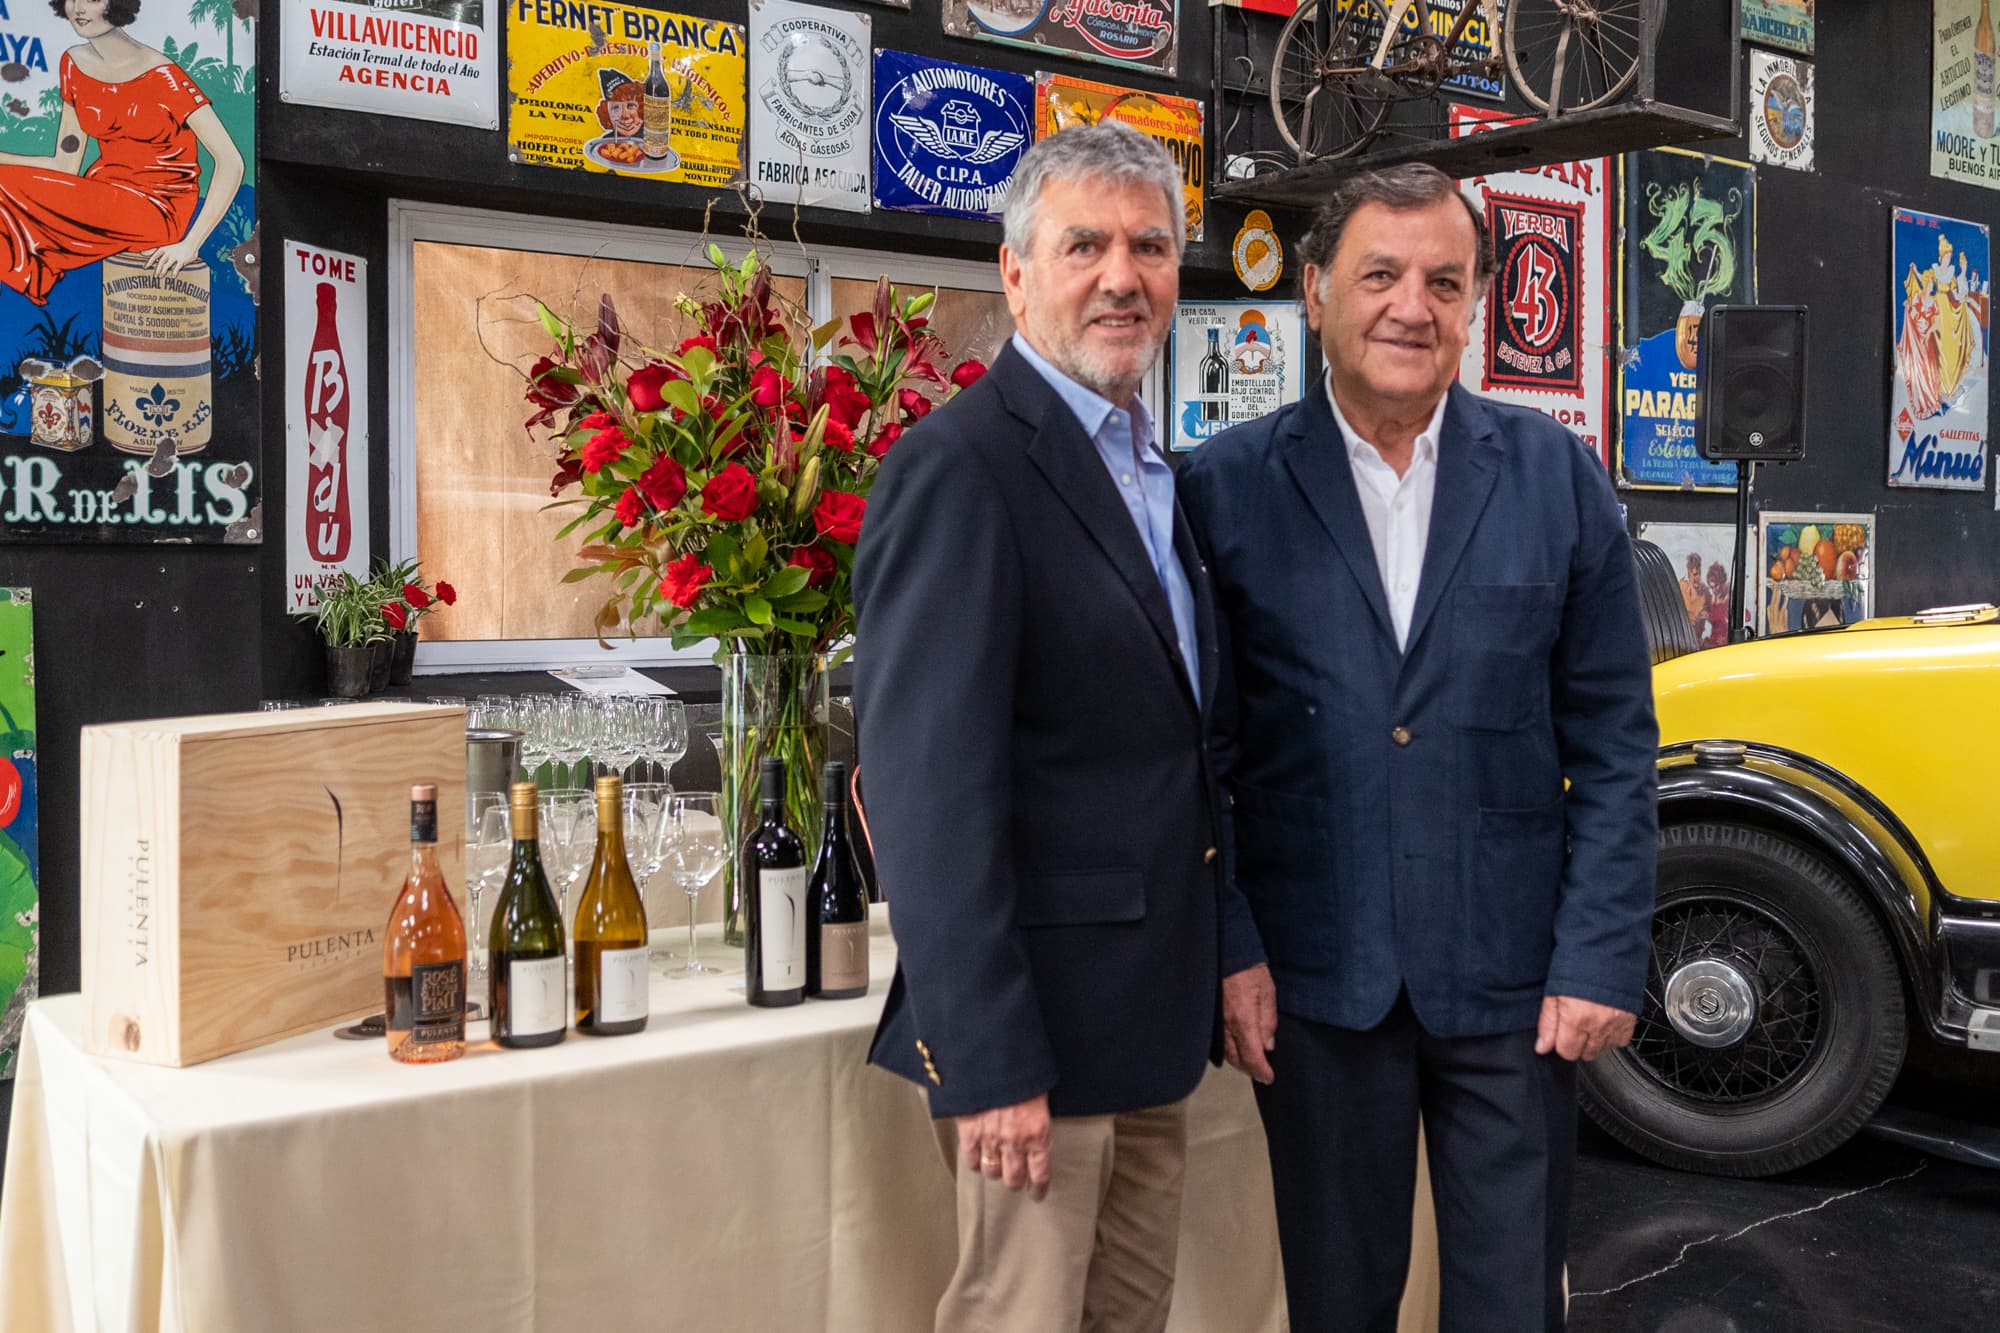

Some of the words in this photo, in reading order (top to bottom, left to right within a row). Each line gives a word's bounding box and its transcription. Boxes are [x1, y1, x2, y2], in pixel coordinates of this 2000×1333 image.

[309, 8, 478, 61] VILLAVICENCIO
[622, 10, 737, 56] BRANCA
[782, 20, 847, 44] COOPERATIVA
[1099, 30, 1139, 46] ROSARIO
[308, 42, 361, 62] Estación
[363, 49, 402, 68] Termal
[404, 57, 419, 70] de
[421, 59, 447, 74] todo
[448, 63, 458, 75] el
[459, 66, 480, 79] Año
[1950, 44, 1959, 57] EL
[338, 65, 451, 97] AGENCIA
[911, 67, 1008, 108] AUTOMOTORES
[518, 97, 593, 113] PROLONGA
[528, 110, 547, 119] LA
[552, 112, 586, 123] VIDA
[770, 98, 825, 137] FABRICANTES
[828, 125, 840, 136] DE
[840, 109, 858, 130] SODA
[1115, 110, 1173, 132] Fumadores
[670, 127, 682, 135] EN
[685, 130, 708, 139] TODO
[779, 131, 807, 152] AGUAS
[810, 138, 850, 155] GASEOSAS
[1936, 129, 1976, 160] MOORE
[1980, 146, 1987, 162] Y
[1949, 157, 1986, 177] BUENOS
[896, 160, 943, 205] TALLER
[1500, 209, 1570, 253] YERBA
[296, 249, 356, 283] TOME
[112, 274, 162, 294] INDUSTRIAL
[1511, 242, 1559, 347] 43
[113, 312, 137, 326] CAPITAL
[1180, 308, 1197, 316] ESTA
[1198, 308, 1217, 316] CASA
[1497, 340, 1543, 374] ESTEVEZ
[1545, 355, 1556, 374] &
[1230, 387, 1247, 395] BAJO
[1249, 387, 1276, 396] CONTROL
[1231, 379, 1276, 388] EMBOTELLADO
[1241, 396, 1267, 404] OFICIAL
[1247, 403, 1259, 411] DEL
[181, 399, 212, 434] LIS
[1940, 429, 1980, 442] GALLETITAS
[1891, 429, 1984, 483] Minué
[123, 456, 254, 526] LIS
[294, 574, 313, 589] UN
[295, 593, 304, 607] Y
[135, 839, 150, 967] PULENTA
[287, 927, 375, 963] PULENTA
